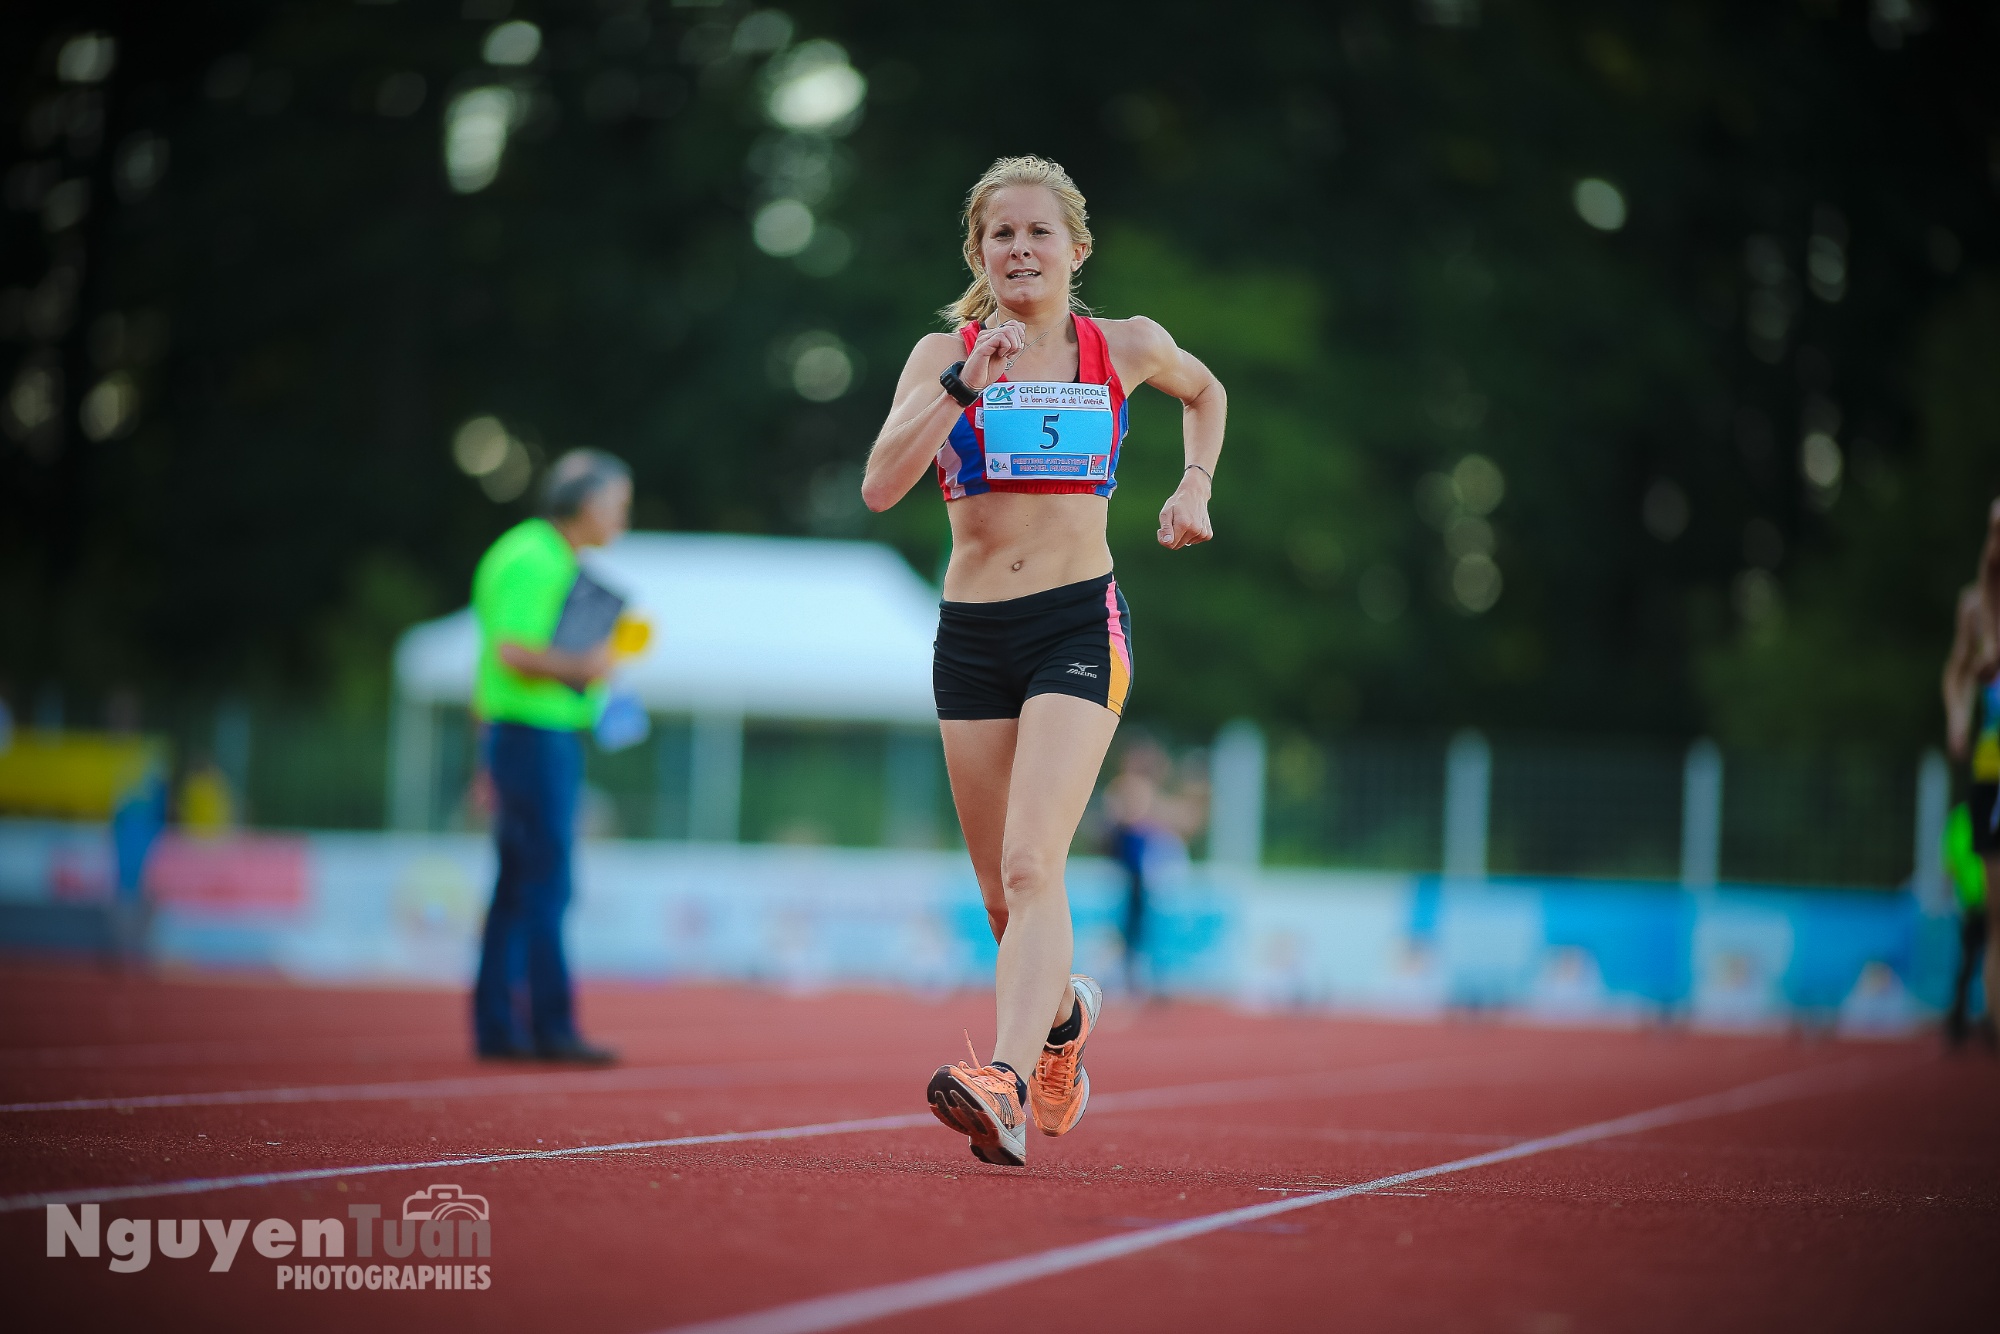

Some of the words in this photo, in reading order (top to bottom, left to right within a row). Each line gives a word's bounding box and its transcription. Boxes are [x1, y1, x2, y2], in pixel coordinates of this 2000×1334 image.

[1019, 385, 1057, 394] CRÉDIT
[1060, 387, 1108, 397] AGRICOLE
[1020, 395, 1029, 403] Le
[1031, 395, 1043, 403] bon
[1039, 413, 1060, 450] 5
